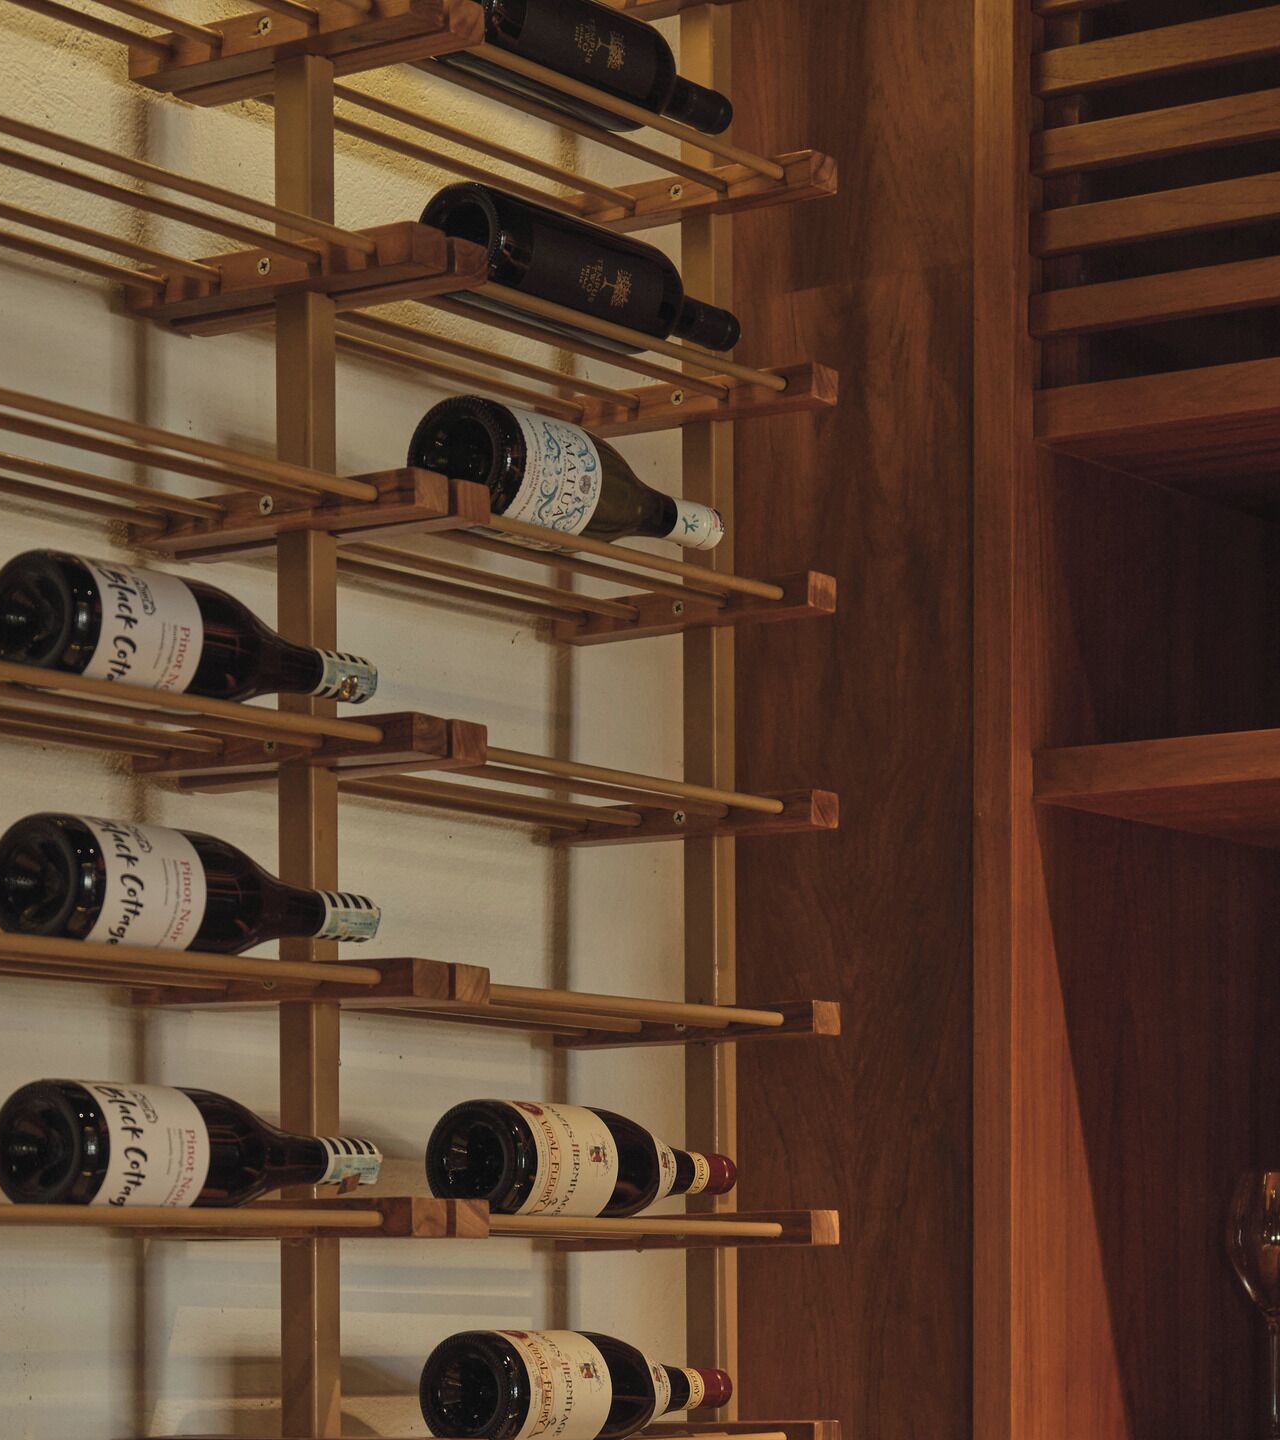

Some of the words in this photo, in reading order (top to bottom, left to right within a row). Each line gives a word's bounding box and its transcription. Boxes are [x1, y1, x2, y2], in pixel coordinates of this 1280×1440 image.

[551, 440, 577, 519] MATUA
[172, 626, 191, 670] Pinot
[179, 860, 193, 905] Pinot
[169, 908, 191, 943] Noir
[108, 1146, 148, 1207] Cottag
[184, 1128, 197, 1173] Pinot
[539, 1120, 561, 1207] VIDAL-FLEURY
[527, 1342, 552, 1426] VIDAL-FLEURY
